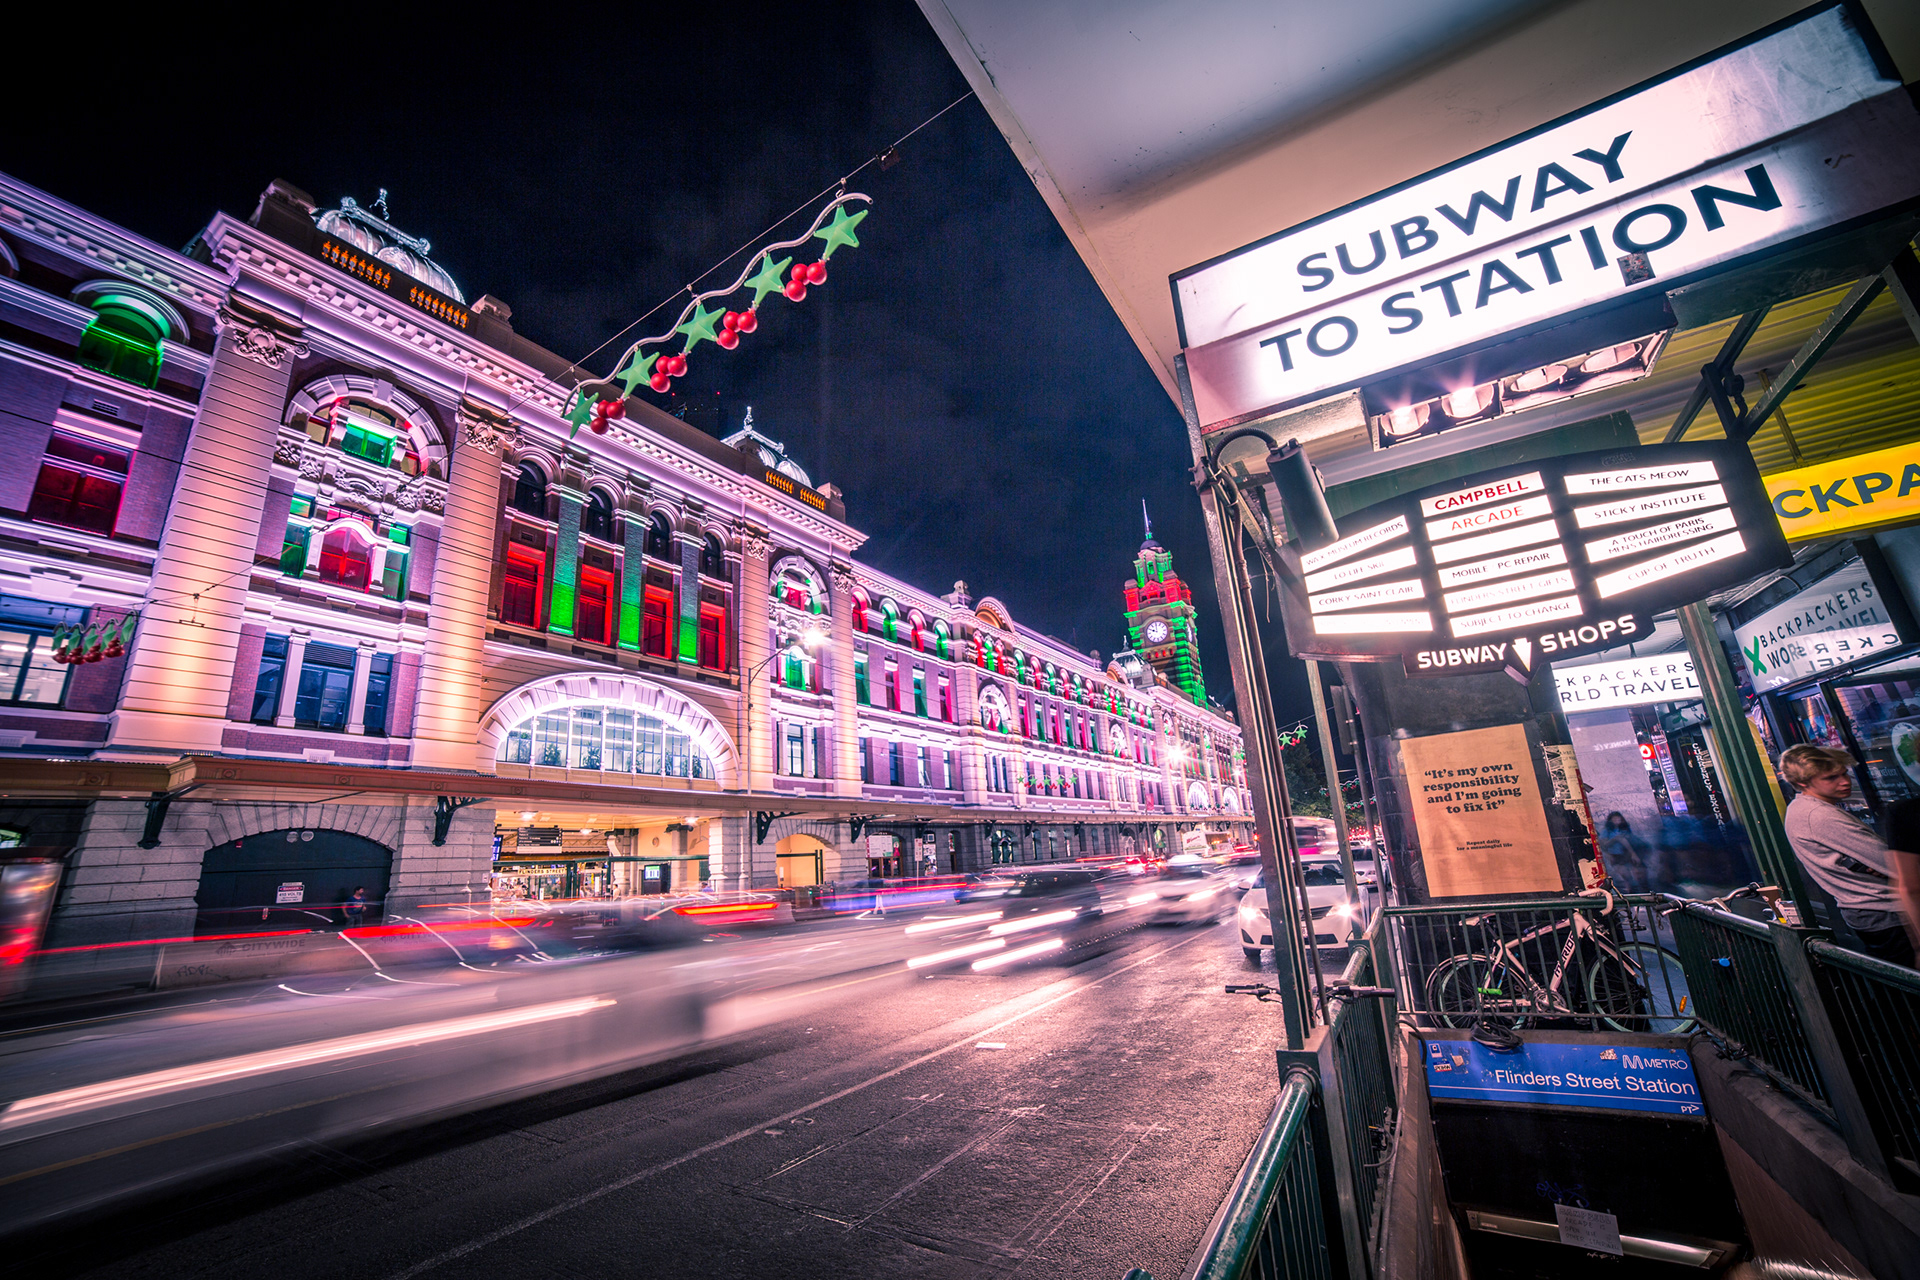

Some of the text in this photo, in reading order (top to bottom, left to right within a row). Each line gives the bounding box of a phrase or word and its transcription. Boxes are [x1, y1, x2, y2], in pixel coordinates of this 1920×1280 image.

[1296, 129, 1633, 293] SUBWAY
[1259, 162, 1783, 372] TO STATION
[1590, 469, 1690, 486] THE CATS MEOW
[1434, 480, 1529, 510] CAMPBELL
[1594, 493, 1706, 519] STICKY INSTITUTE
[1451, 506, 1525, 531] ARCADE
[1622, 530, 1657, 543] TOUCH
[1659, 525, 1672, 533] OF
[1675, 518, 1705, 529] PARIS
[1306, 522, 1404, 566] WAX MUSEUM RECORDS
[1639, 523, 1714, 547] HAIRDRESSING
[1452, 553, 1551, 579] MOBILE PC REPAIR
[1627, 547, 1715, 581] CUP OF TRUTH
[1318, 586, 1414, 606] CORKY SAINT CLAIR
[1460, 602, 1571, 629] SUBJECT TO CHANGE
[1760, 582, 1873, 648] BACKPACKERS
[1417, 614, 1637, 669] SUBWAY SHOPS
[1560, 677, 1699, 703] RLD TRAVEL
[1457, 767, 1478, 777] my
[1481, 763, 1513, 773] own
[1692, 743, 1713, 791] CURRENCY
[1423, 774, 1519, 792] responsibility
[1427, 787, 1522, 803] and I’m going
[1445, 805, 1461, 814] to
[1463, 803, 1483, 812] fix
[242, 939, 306, 952] CITYWIDE
[1644, 1058, 1688, 1070] METRO
[1495, 1069, 1695, 1095] Flinders Street Station
